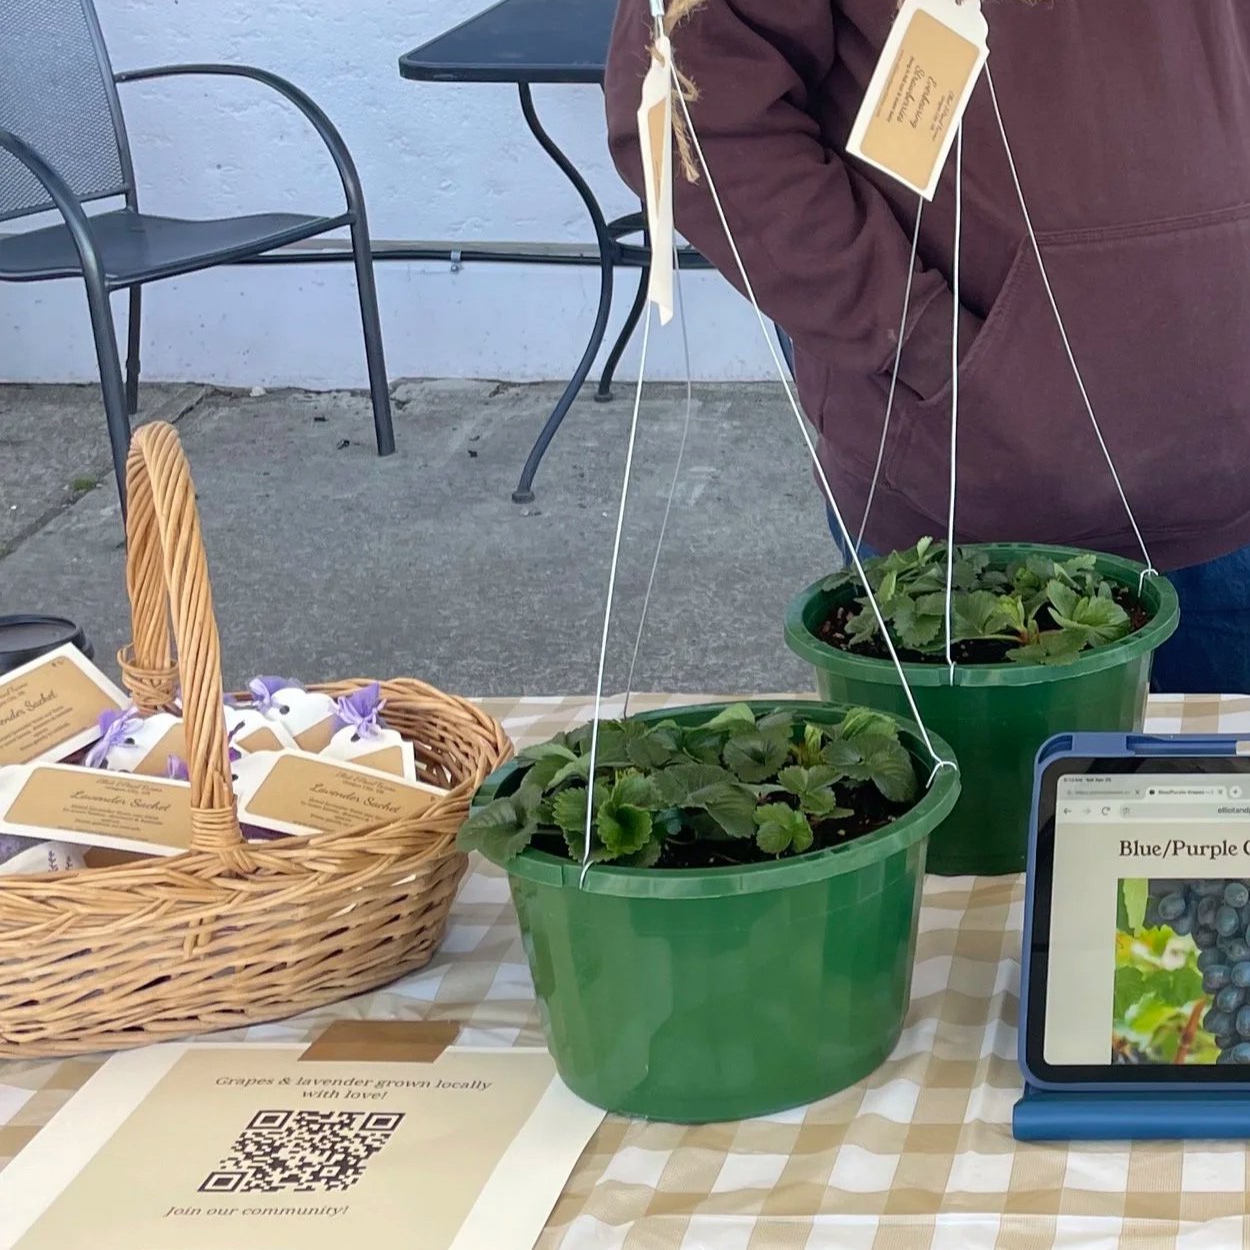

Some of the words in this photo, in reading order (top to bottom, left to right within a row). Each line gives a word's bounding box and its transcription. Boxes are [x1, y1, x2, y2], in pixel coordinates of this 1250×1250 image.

[896, 64, 925, 123] Strawberries
[909, 75, 937, 129] Everbearing
[309, 782, 360, 803] Lavender
[363, 797, 401, 814] Sachet
[1119, 839, 1239, 860] Blue/Purple
[215, 1076, 274, 1087] Grapes
[277, 1077, 292, 1086] &
[296, 1077, 374, 1087] lavender
[374, 1080, 431, 1089] grown
[435, 1080, 494, 1091] locally
[301, 1090, 340, 1099] with
[344, 1090, 389, 1100] love!
[162, 1206, 202, 1218] Join
[205, 1207, 240, 1216] our
[241, 1205, 350, 1218] community!
